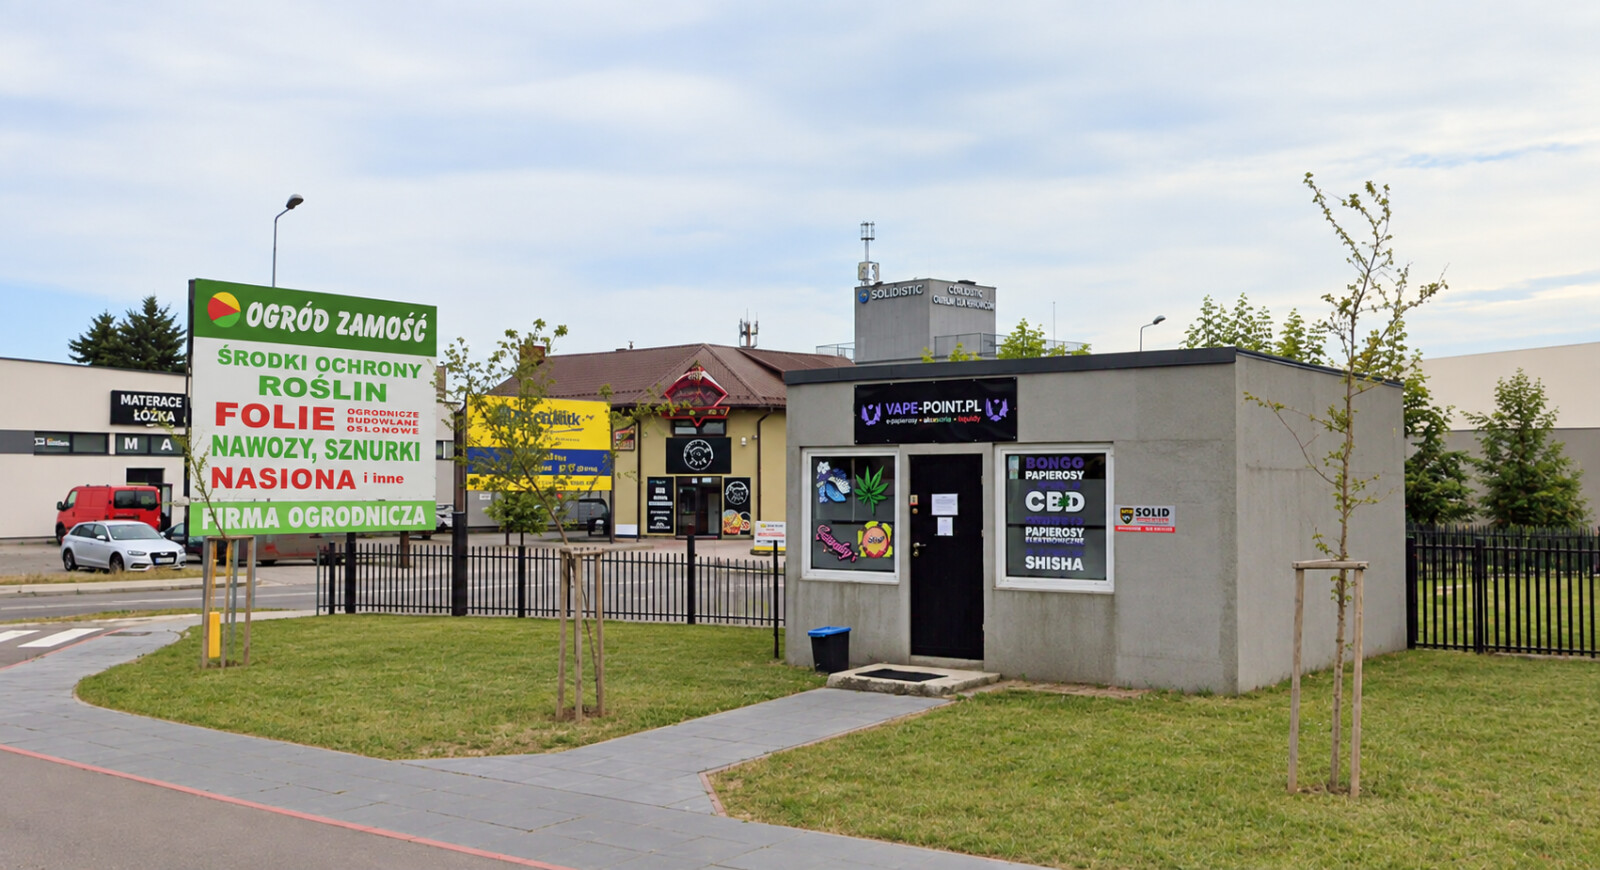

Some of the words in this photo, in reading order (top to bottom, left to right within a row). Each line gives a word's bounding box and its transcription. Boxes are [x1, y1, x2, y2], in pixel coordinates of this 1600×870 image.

[871, 285, 924, 300] SOLIDISTIC
[246, 301, 330, 334] OGRÓD
[336, 312, 428, 343] ZAMOŚĆ
[217, 345, 307, 371] ŚRODKI
[315, 356, 422, 379] OCHRONY
[258, 374, 387, 403] ROŚLIN
[120, 394, 182, 408] MATERACE
[886, 400, 982, 415] VAPE-POINT.PL
[133, 407, 175, 422] ŁÓŻKA
[215, 402, 335, 432] FOLIE
[347, 408, 420, 418] OGRODNICZE
[347, 417, 419, 426] BUDOWLANE
[347, 425, 419, 435] OSLONOWE
[124, 437, 138, 450] M
[160, 438, 173, 451] A
[212, 434, 317, 464] NAWOZY,
[324, 439, 420, 462] SZNURKI
[211, 466, 356, 490] NASIONA
[363, 472, 368, 483] i
[373, 472, 404, 484] inne
[1025, 470, 1085, 481] PAPIEROSY
[1025, 490, 1086, 513] CBD
[202, 506, 280, 530] FIRMA
[287, 505, 426, 528] OGRODNICZA
[1135, 507, 1170, 517] SOLID
[1025, 527, 1085, 538] PAPIEROSY
[1025, 555, 1085, 571] SHISHA
